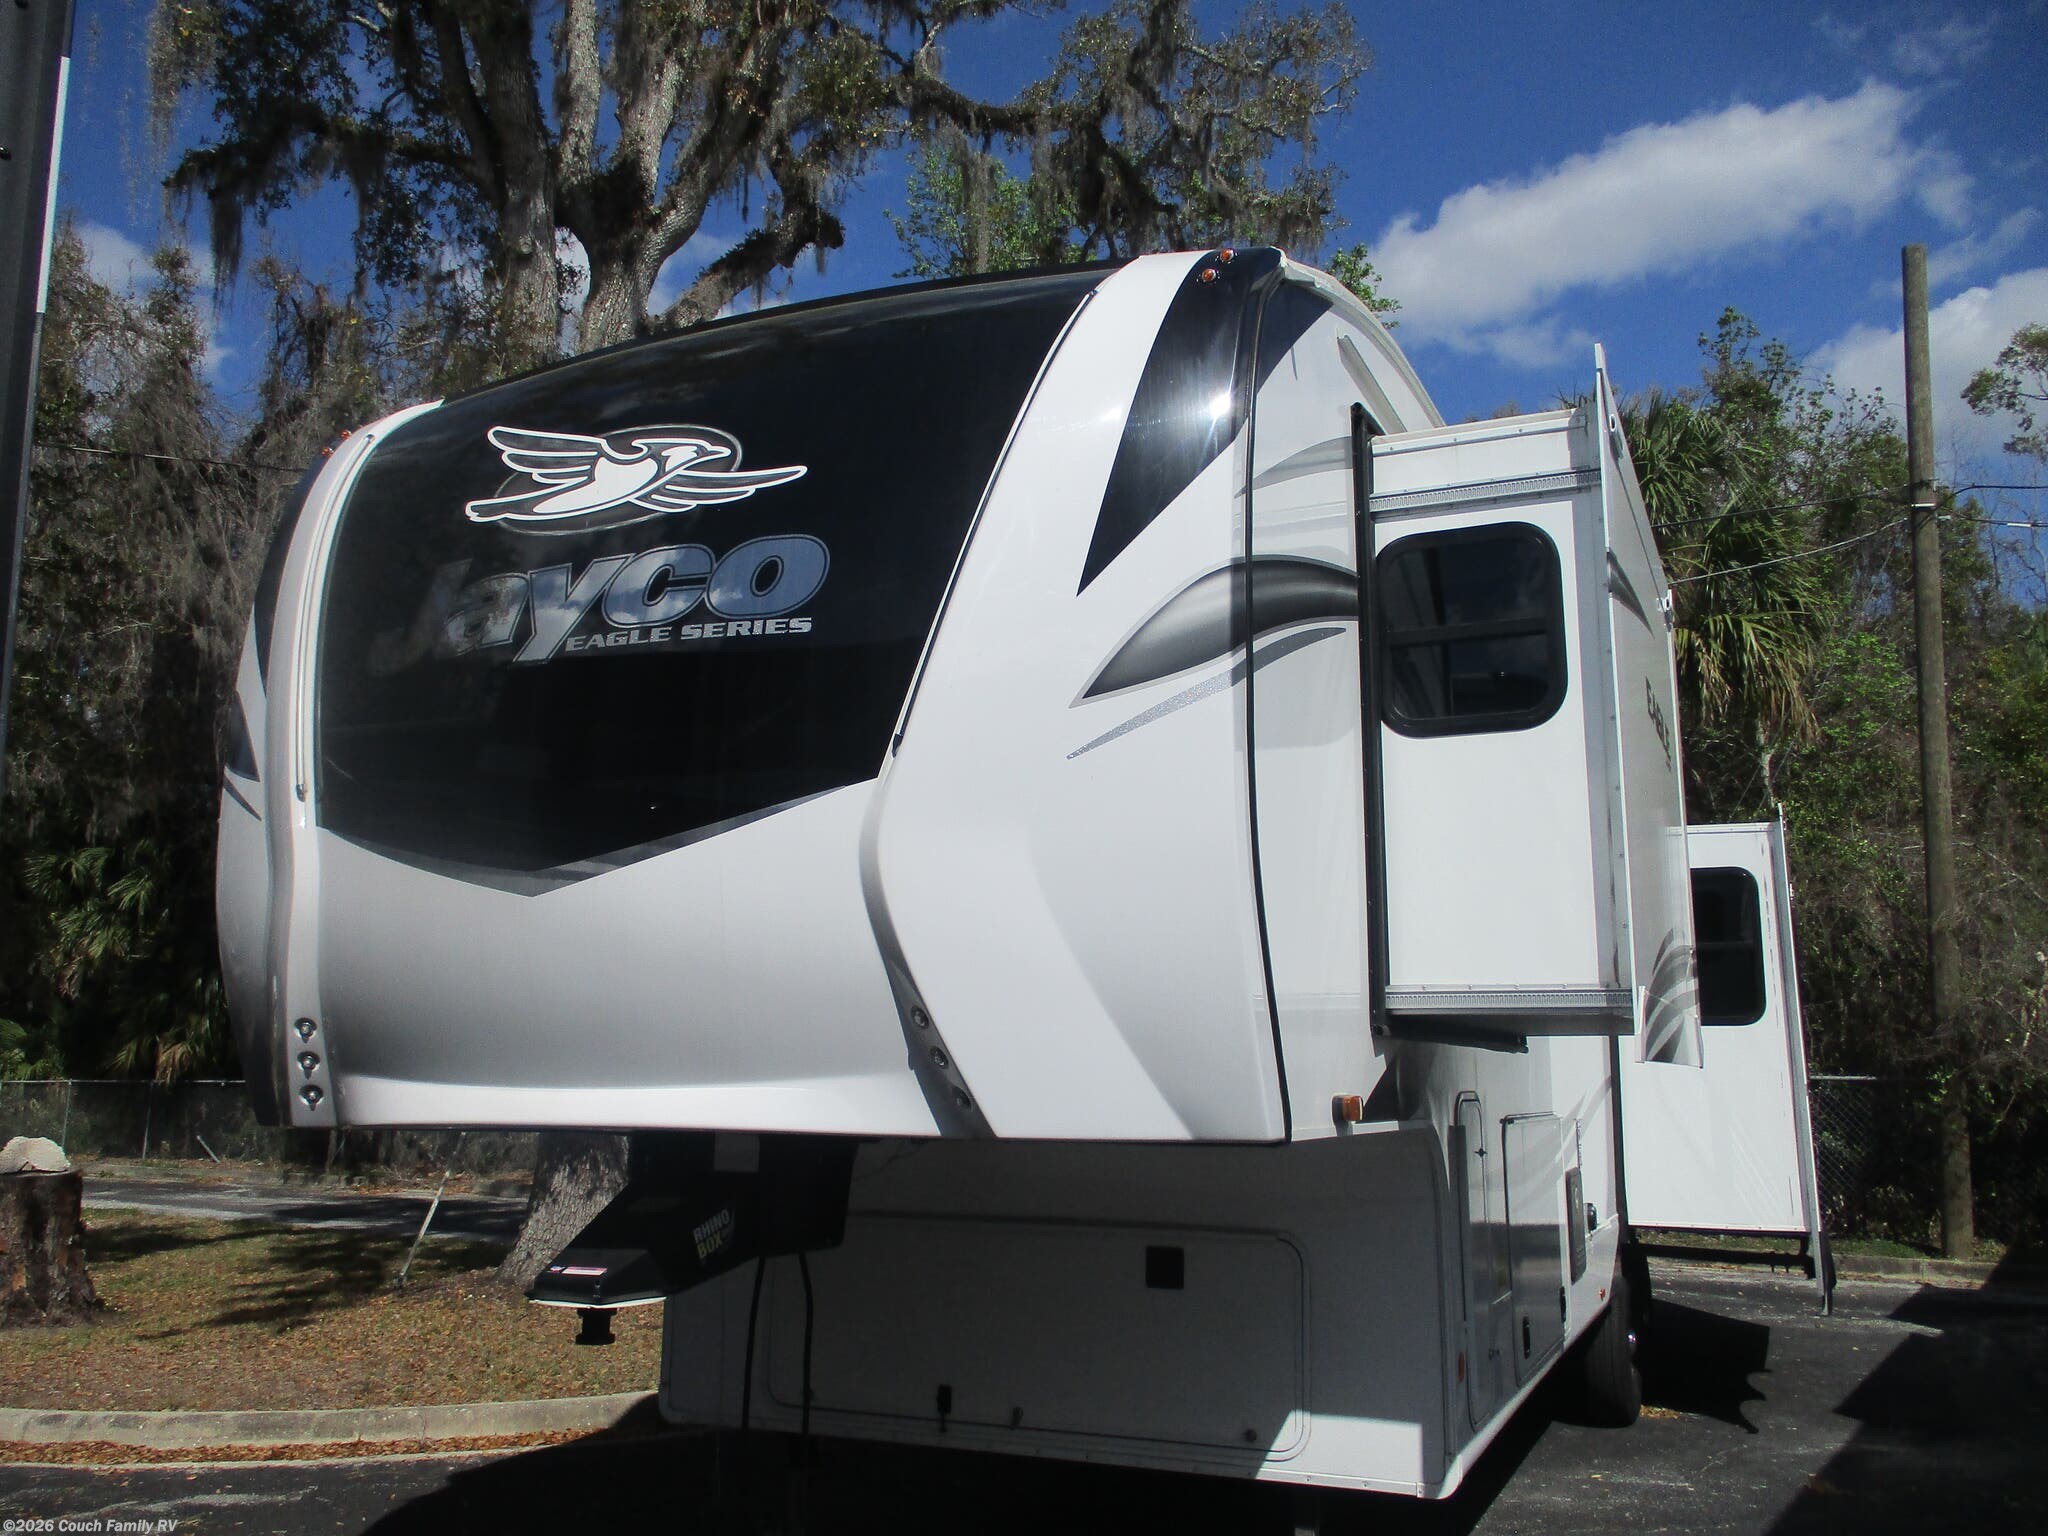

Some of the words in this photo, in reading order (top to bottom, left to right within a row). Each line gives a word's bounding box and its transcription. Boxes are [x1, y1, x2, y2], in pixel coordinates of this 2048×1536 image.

[565, 625, 672, 652] EAGLE
[682, 617, 812, 641] SERIES
[692, 1208, 730, 1243] RHINO
[696, 1230, 723, 1259] BOX
